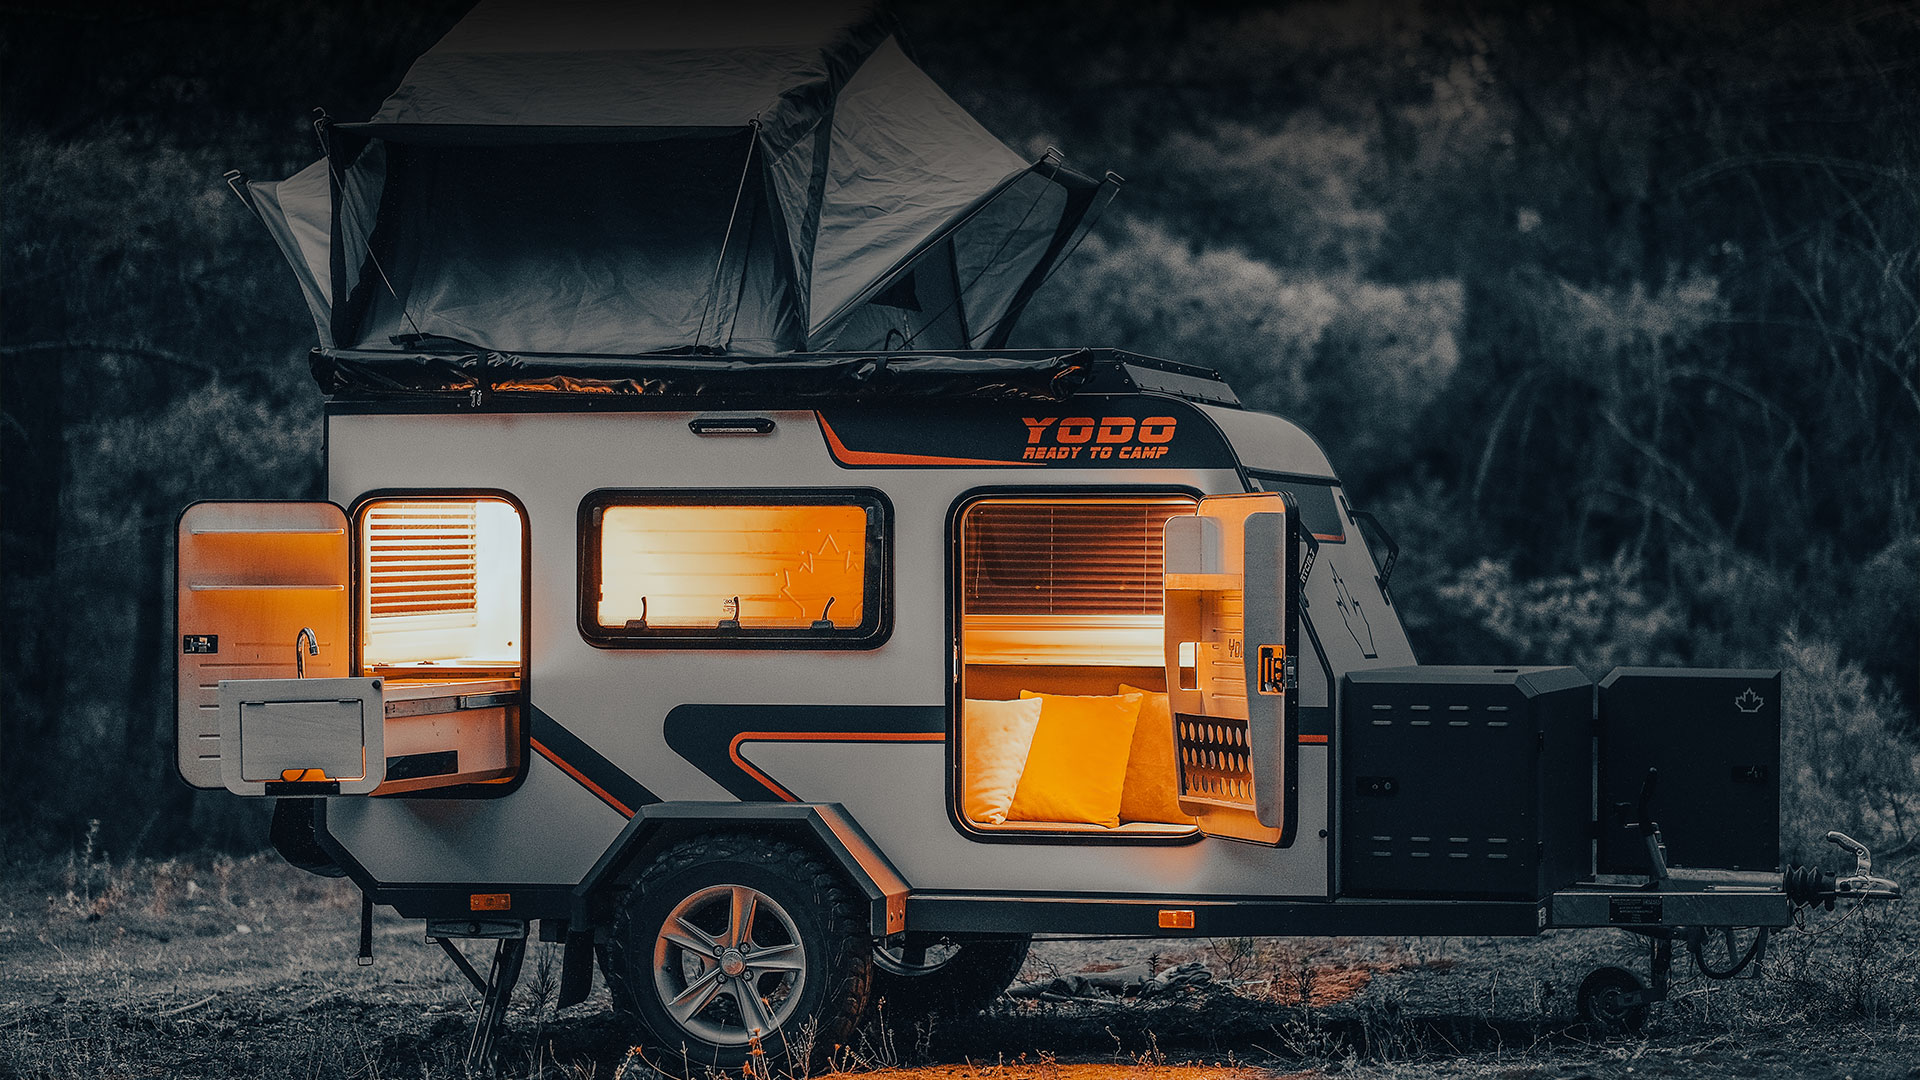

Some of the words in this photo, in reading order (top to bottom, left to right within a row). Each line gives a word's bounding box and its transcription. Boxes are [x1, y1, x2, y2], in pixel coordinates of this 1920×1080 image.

[1021, 416, 1178, 444] YODO
[1022, 446, 1083, 460] READY
[1089, 446, 1114, 460] TO
[1118, 446, 1170, 460] CAMP
